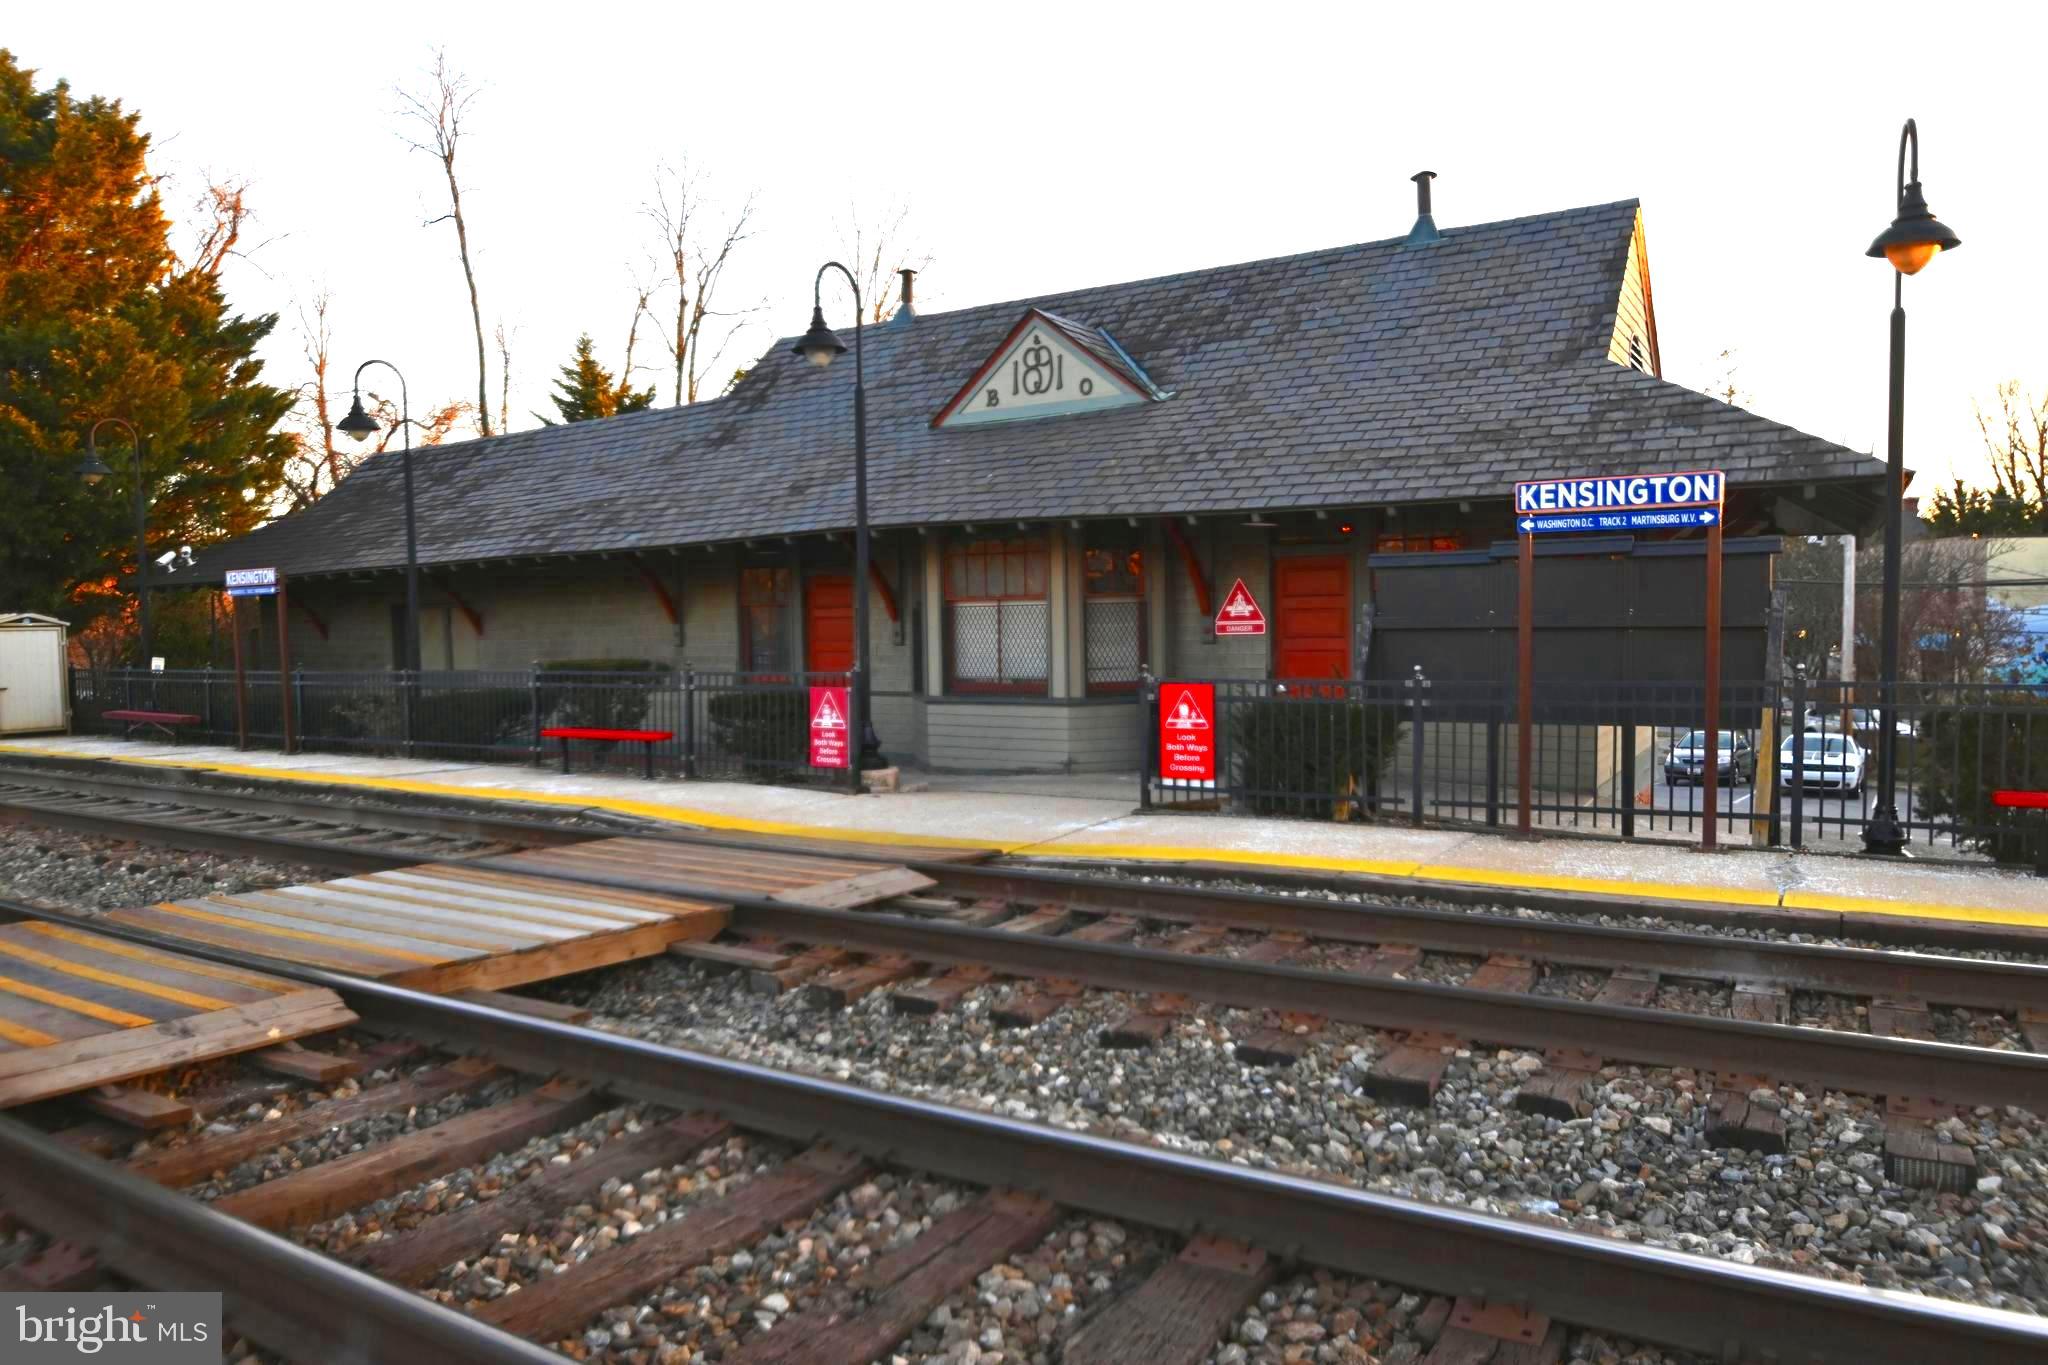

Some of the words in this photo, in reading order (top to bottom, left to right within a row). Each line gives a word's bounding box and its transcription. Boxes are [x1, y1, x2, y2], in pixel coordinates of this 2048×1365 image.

[1012, 345, 1063, 395] 1891
[986, 388, 999, 407] B
[1079, 377, 1093, 396] O
[1520, 475, 1715, 510] KENSINGTON
[1537, 518, 1581, 529] WASHINGTON
[1581, 517, 1594, 528] D.C.
[1599, 516, 1621, 526] TRACK
[1621, 516, 1627, 526] 2
[1631, 513, 1680, 525] MARTINSBURG
[1681, 513, 1697, 523] W.V.
[226, 570, 275, 585] KENSINGTON
[1176, 733, 1196, 741] Look
[829, 740, 844, 748] Ways
[1165, 742, 1185, 751] Both
[1186, 743, 1209, 753] Ways
[1173, 753, 1201, 762] Before
[1170, 763, 1205, 774] Crossing
